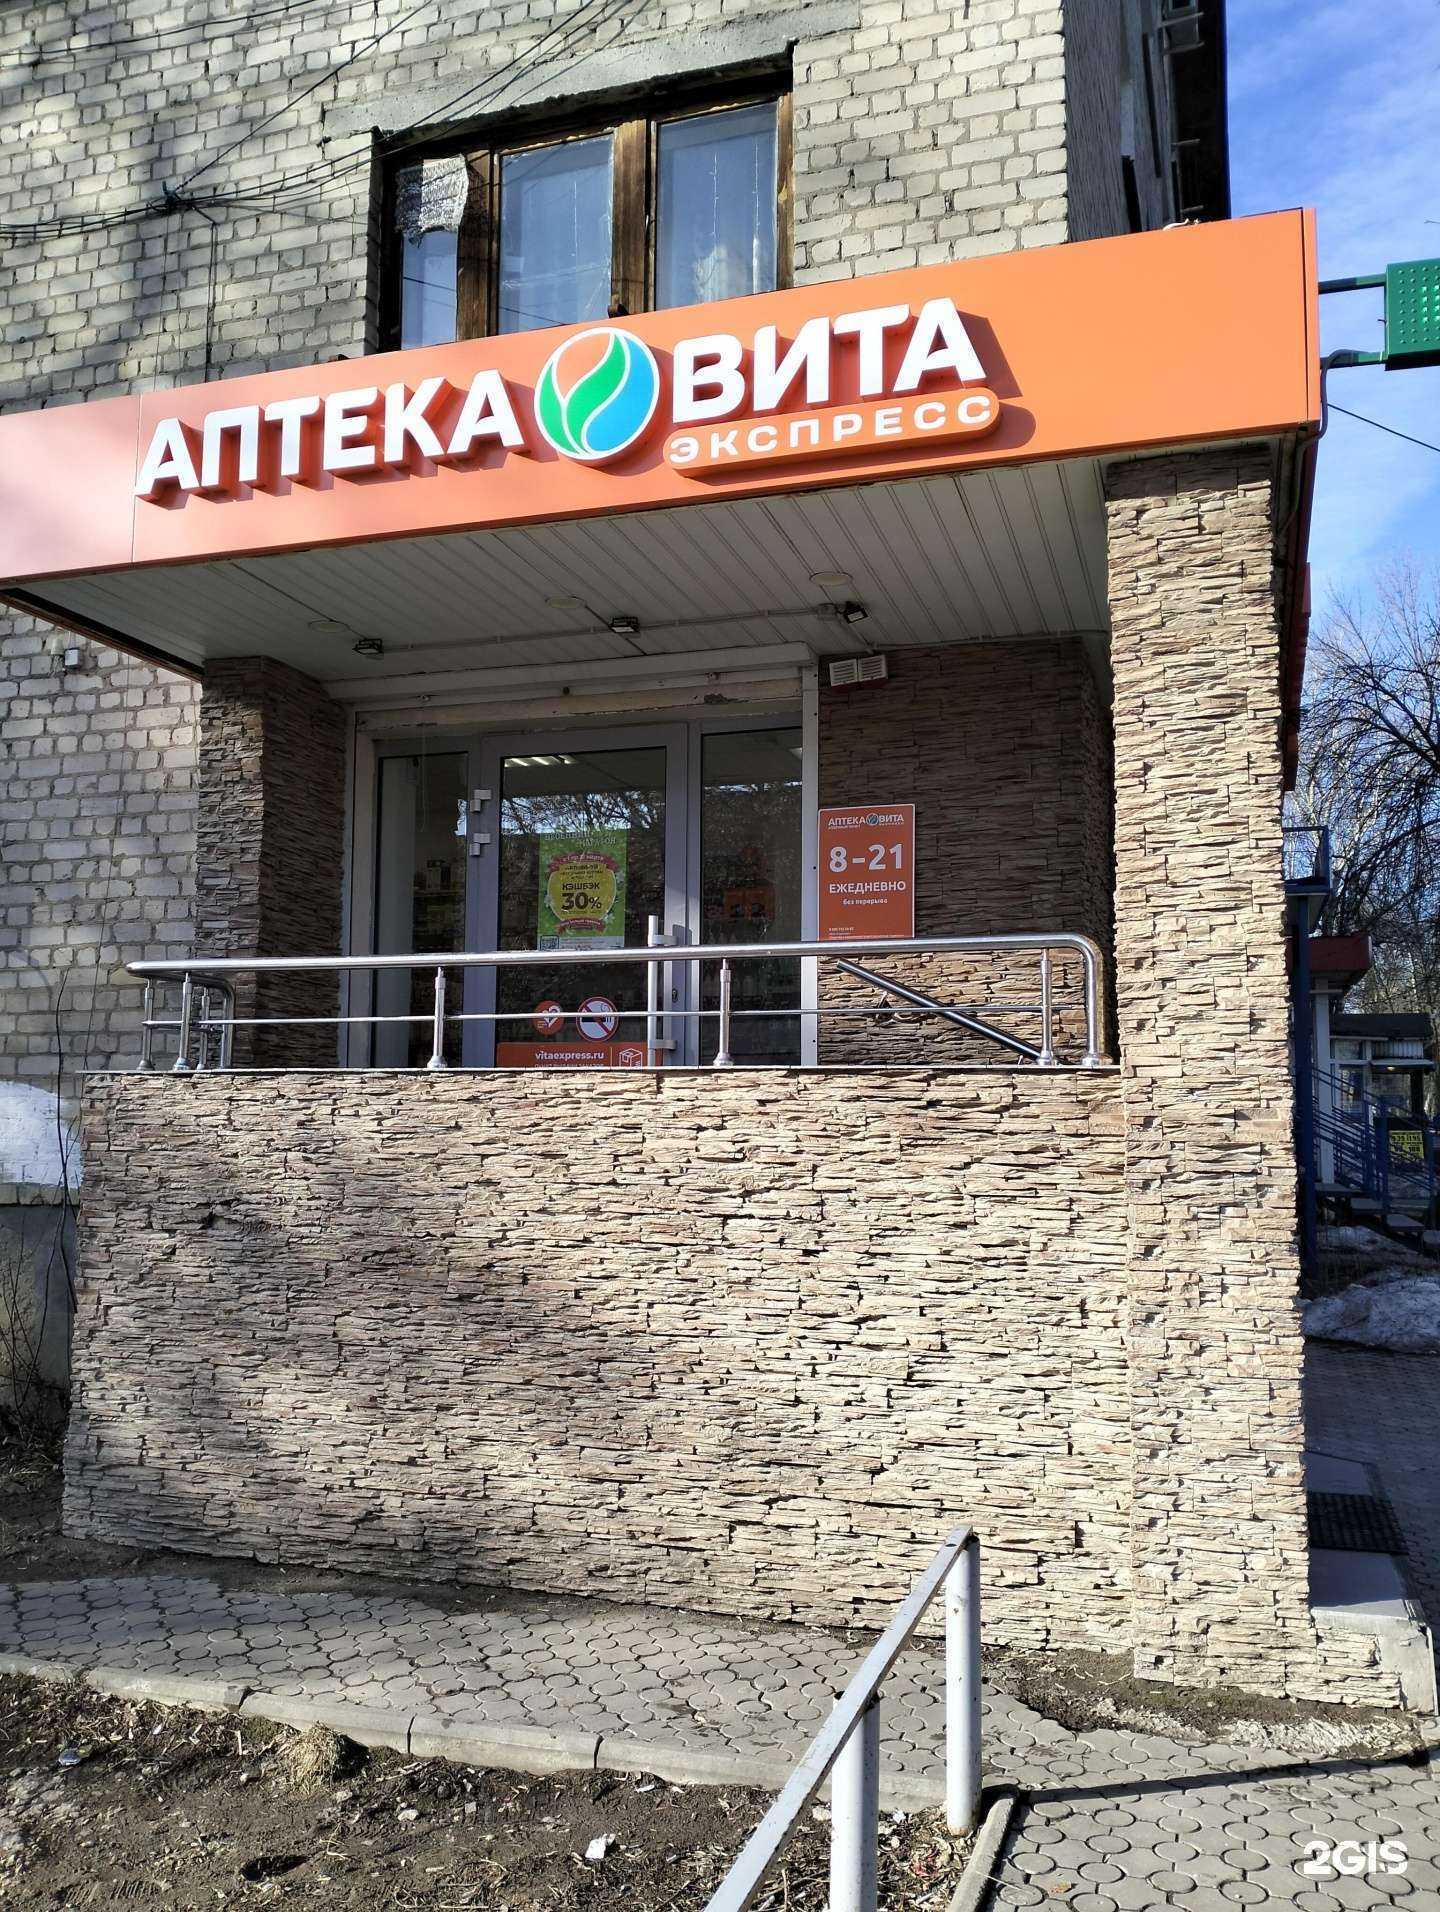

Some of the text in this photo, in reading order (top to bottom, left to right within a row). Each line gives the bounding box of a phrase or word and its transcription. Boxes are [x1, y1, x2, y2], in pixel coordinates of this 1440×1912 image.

[133, 297, 987, 497] АПТЕКА ВИТА
[668, 395, 992, 465] ЭКСПРЕСС
[828, 814, 905, 826] АПТЕКА ВИТА
[829, 881, 906, 895] ЕЖЕДНЕВНО
[561, 892, 602, 910] 30%
[535, 1051, 605, 1062] vitaexpress.ru
